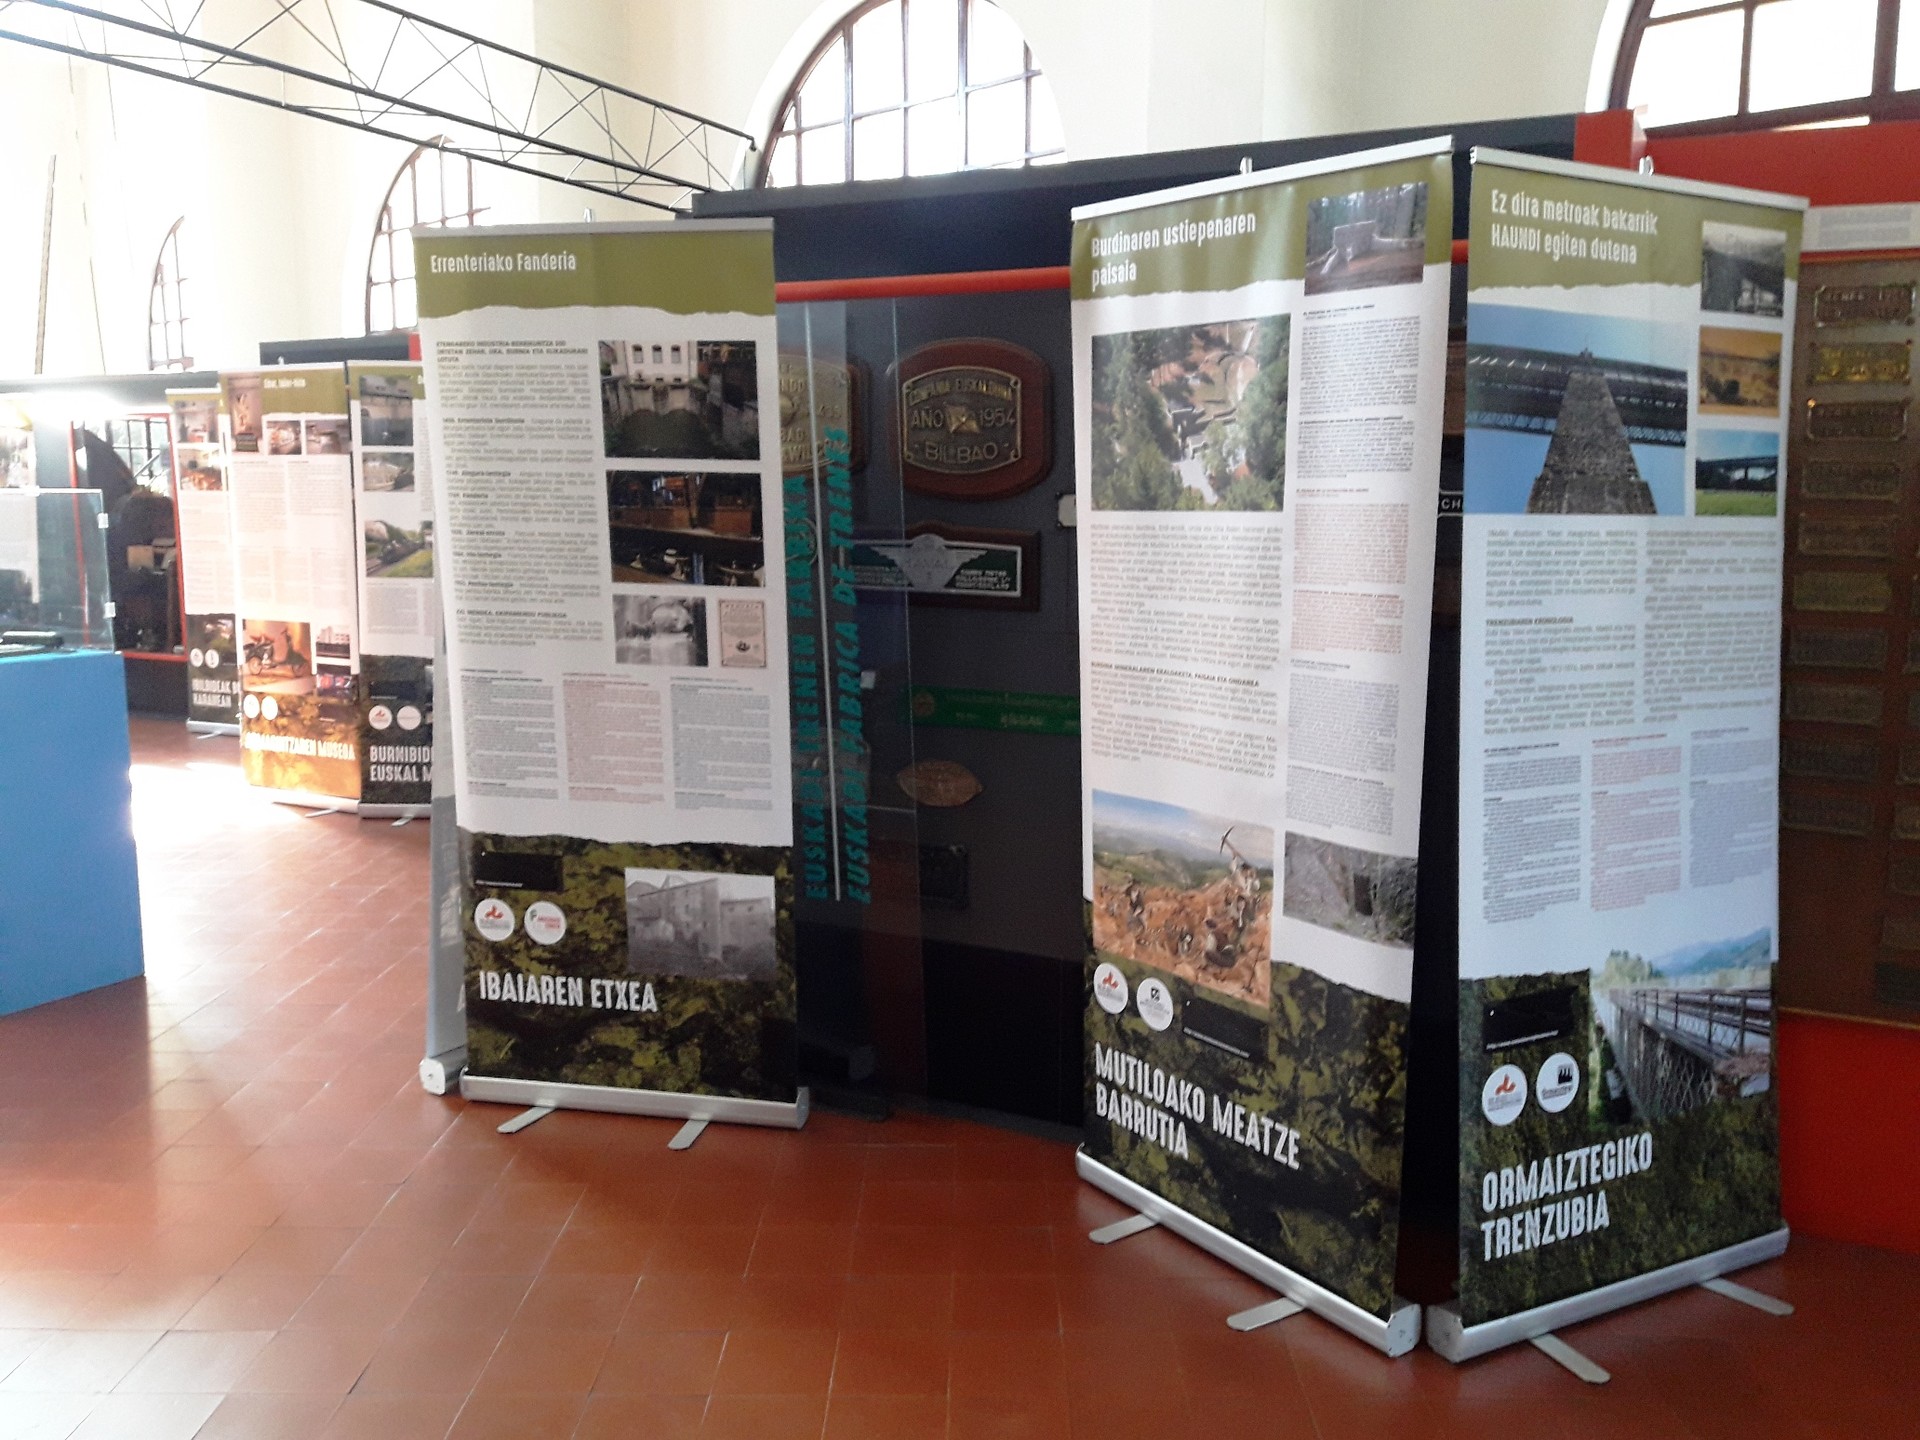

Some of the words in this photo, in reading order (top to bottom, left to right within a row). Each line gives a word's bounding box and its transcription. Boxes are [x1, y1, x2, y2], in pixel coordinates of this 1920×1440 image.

[1091, 229, 1160, 258] Burdinaren
[1162, 211, 1257, 246] ustiepenaren
[1491, 188, 1507, 215] Ez
[1511, 190, 1539, 219] dira
[1543, 200, 1600, 228] metroak
[1602, 204, 1659, 236] bakarrik
[430, 251, 513, 274] Errenteriako
[517, 249, 578, 272] Fanderia
[1491, 223, 1541, 253] HAUNDI
[1544, 230, 1587, 262] egiten
[1590, 237, 1638, 265] dutena
[1091, 259, 1137, 292] paisaia
[911, 406, 945, 429] AÑO
[979, 407, 1016, 428] 1954
[925, 440, 998, 464] BILBAO
[831, 563, 858, 606] DE
[791, 633, 821, 752] TRENEN
[834, 622, 864, 755] FABRICA
[369, 765, 419, 782] EUSKAL
[799, 768, 829, 902] EUSKADI
[842, 768, 872, 905] EUSKADI
[478, 970, 585, 1007] IBAIAREN
[590, 978, 658, 1013] ETXEA
[1094, 1041, 1206, 1124] MUTILOAKO
[1212, 1093, 1302, 1171] MEATZE
[1094, 1080, 1189, 1161] BARRUTIA
[1482, 1131, 1654, 1215] ORMAIZTEGIKO
[1480, 1189, 1611, 1262] TRENZUBIA
